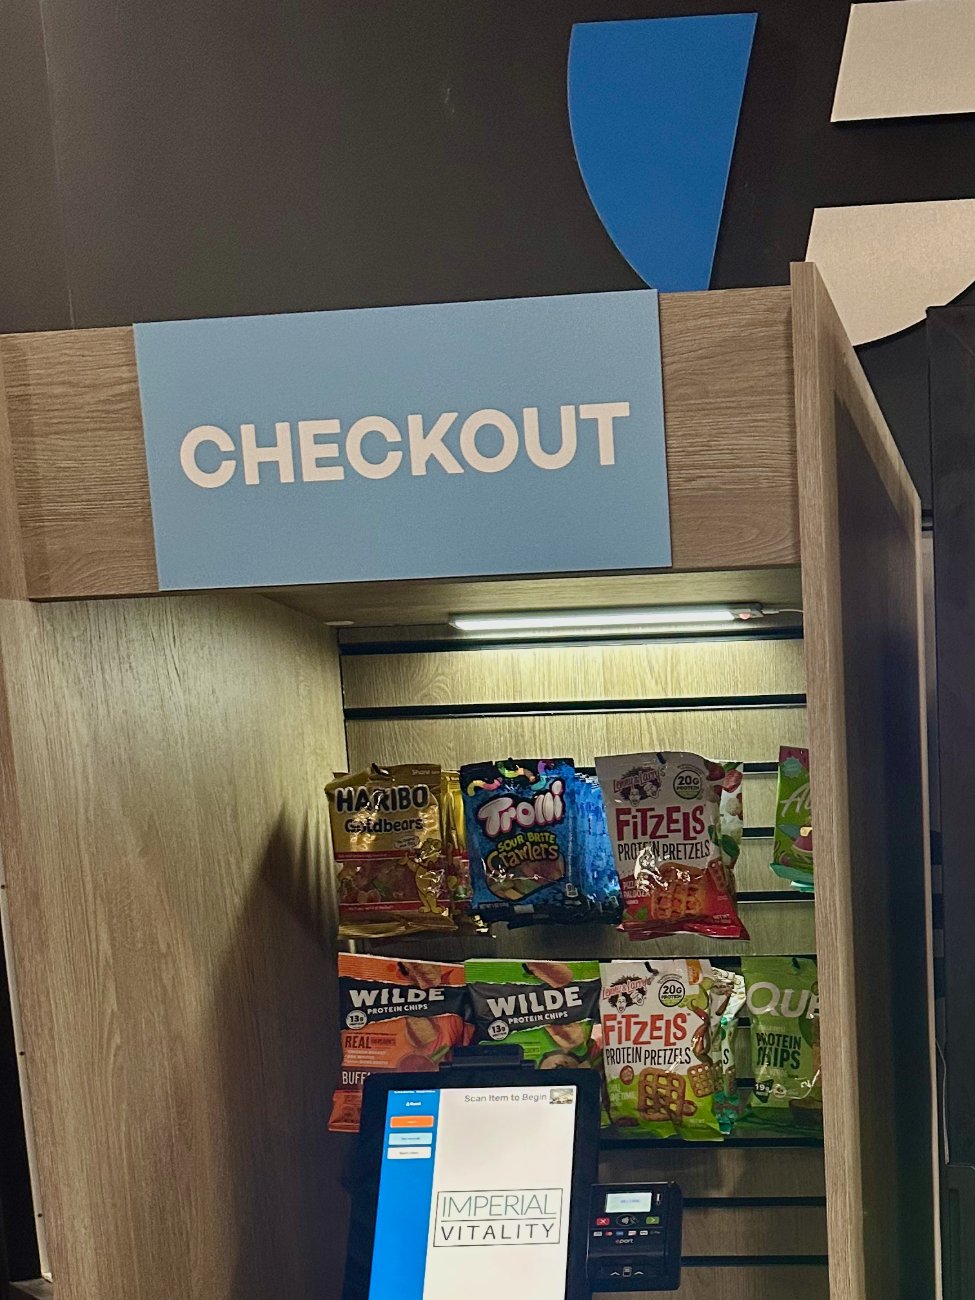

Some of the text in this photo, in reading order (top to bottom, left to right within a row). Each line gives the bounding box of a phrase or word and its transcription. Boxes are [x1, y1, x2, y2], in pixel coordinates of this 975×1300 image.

[180, 402, 630, 488] CHECKOUT
[336, 785, 429, 813] HARIBO
[479, 780, 563, 835] Trolli
[345, 818, 423, 833] Goldbears
[498, 833, 555, 852] SOUR BRITE
[618, 840, 710, 861] PROTEIN PRETZELS
[487, 844, 558, 872] Crawlers
[350, 988, 445, 1007] WILDE
[487, 987, 583, 1017] WILDE
[367, 1006, 402, 1014] PROTEIN
[508, 1011, 568, 1024] PROTEIN CHIPS
[345, 1036, 371, 1048] REAL
[756, 1033, 801, 1049] PROTEIN
[606, 1047, 691, 1065] PROTEIN PRETZELS
[465, 1094, 486, 1102] Scan
[489, 1094, 509, 1102] Item
[522, 1093, 546, 1102] Begin
[442, 1194, 556, 1218] IMPERIAL
[441, 1223, 555, 1241] VITALITY
